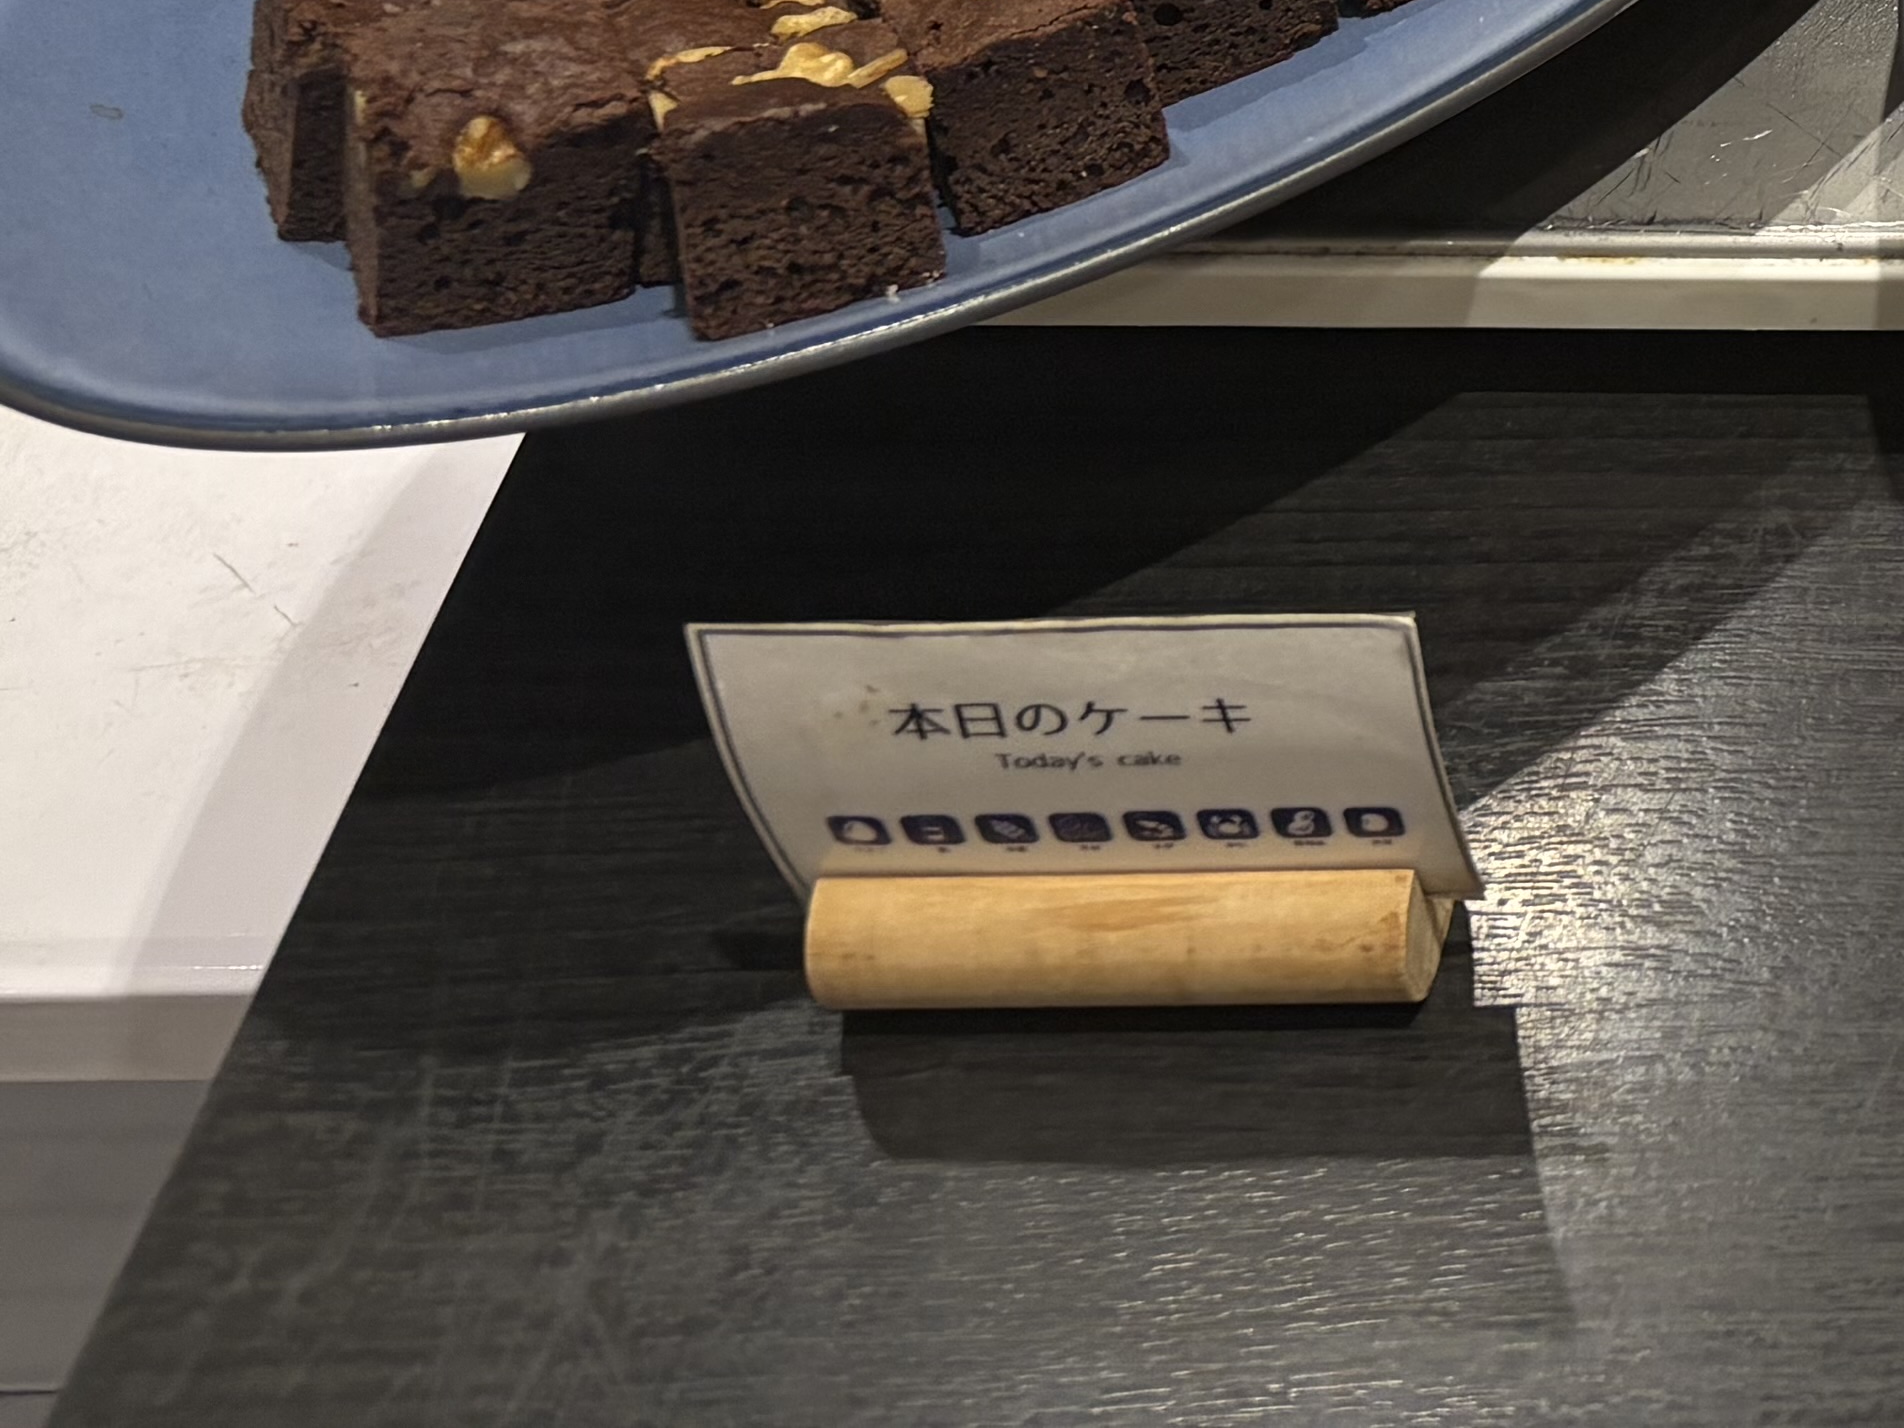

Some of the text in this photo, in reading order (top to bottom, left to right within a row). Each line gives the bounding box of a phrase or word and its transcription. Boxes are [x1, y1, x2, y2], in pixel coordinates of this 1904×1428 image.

[888, 697, 1253, 741] 本日のケーキ
[995, 750, 1184, 772] Today's cake
